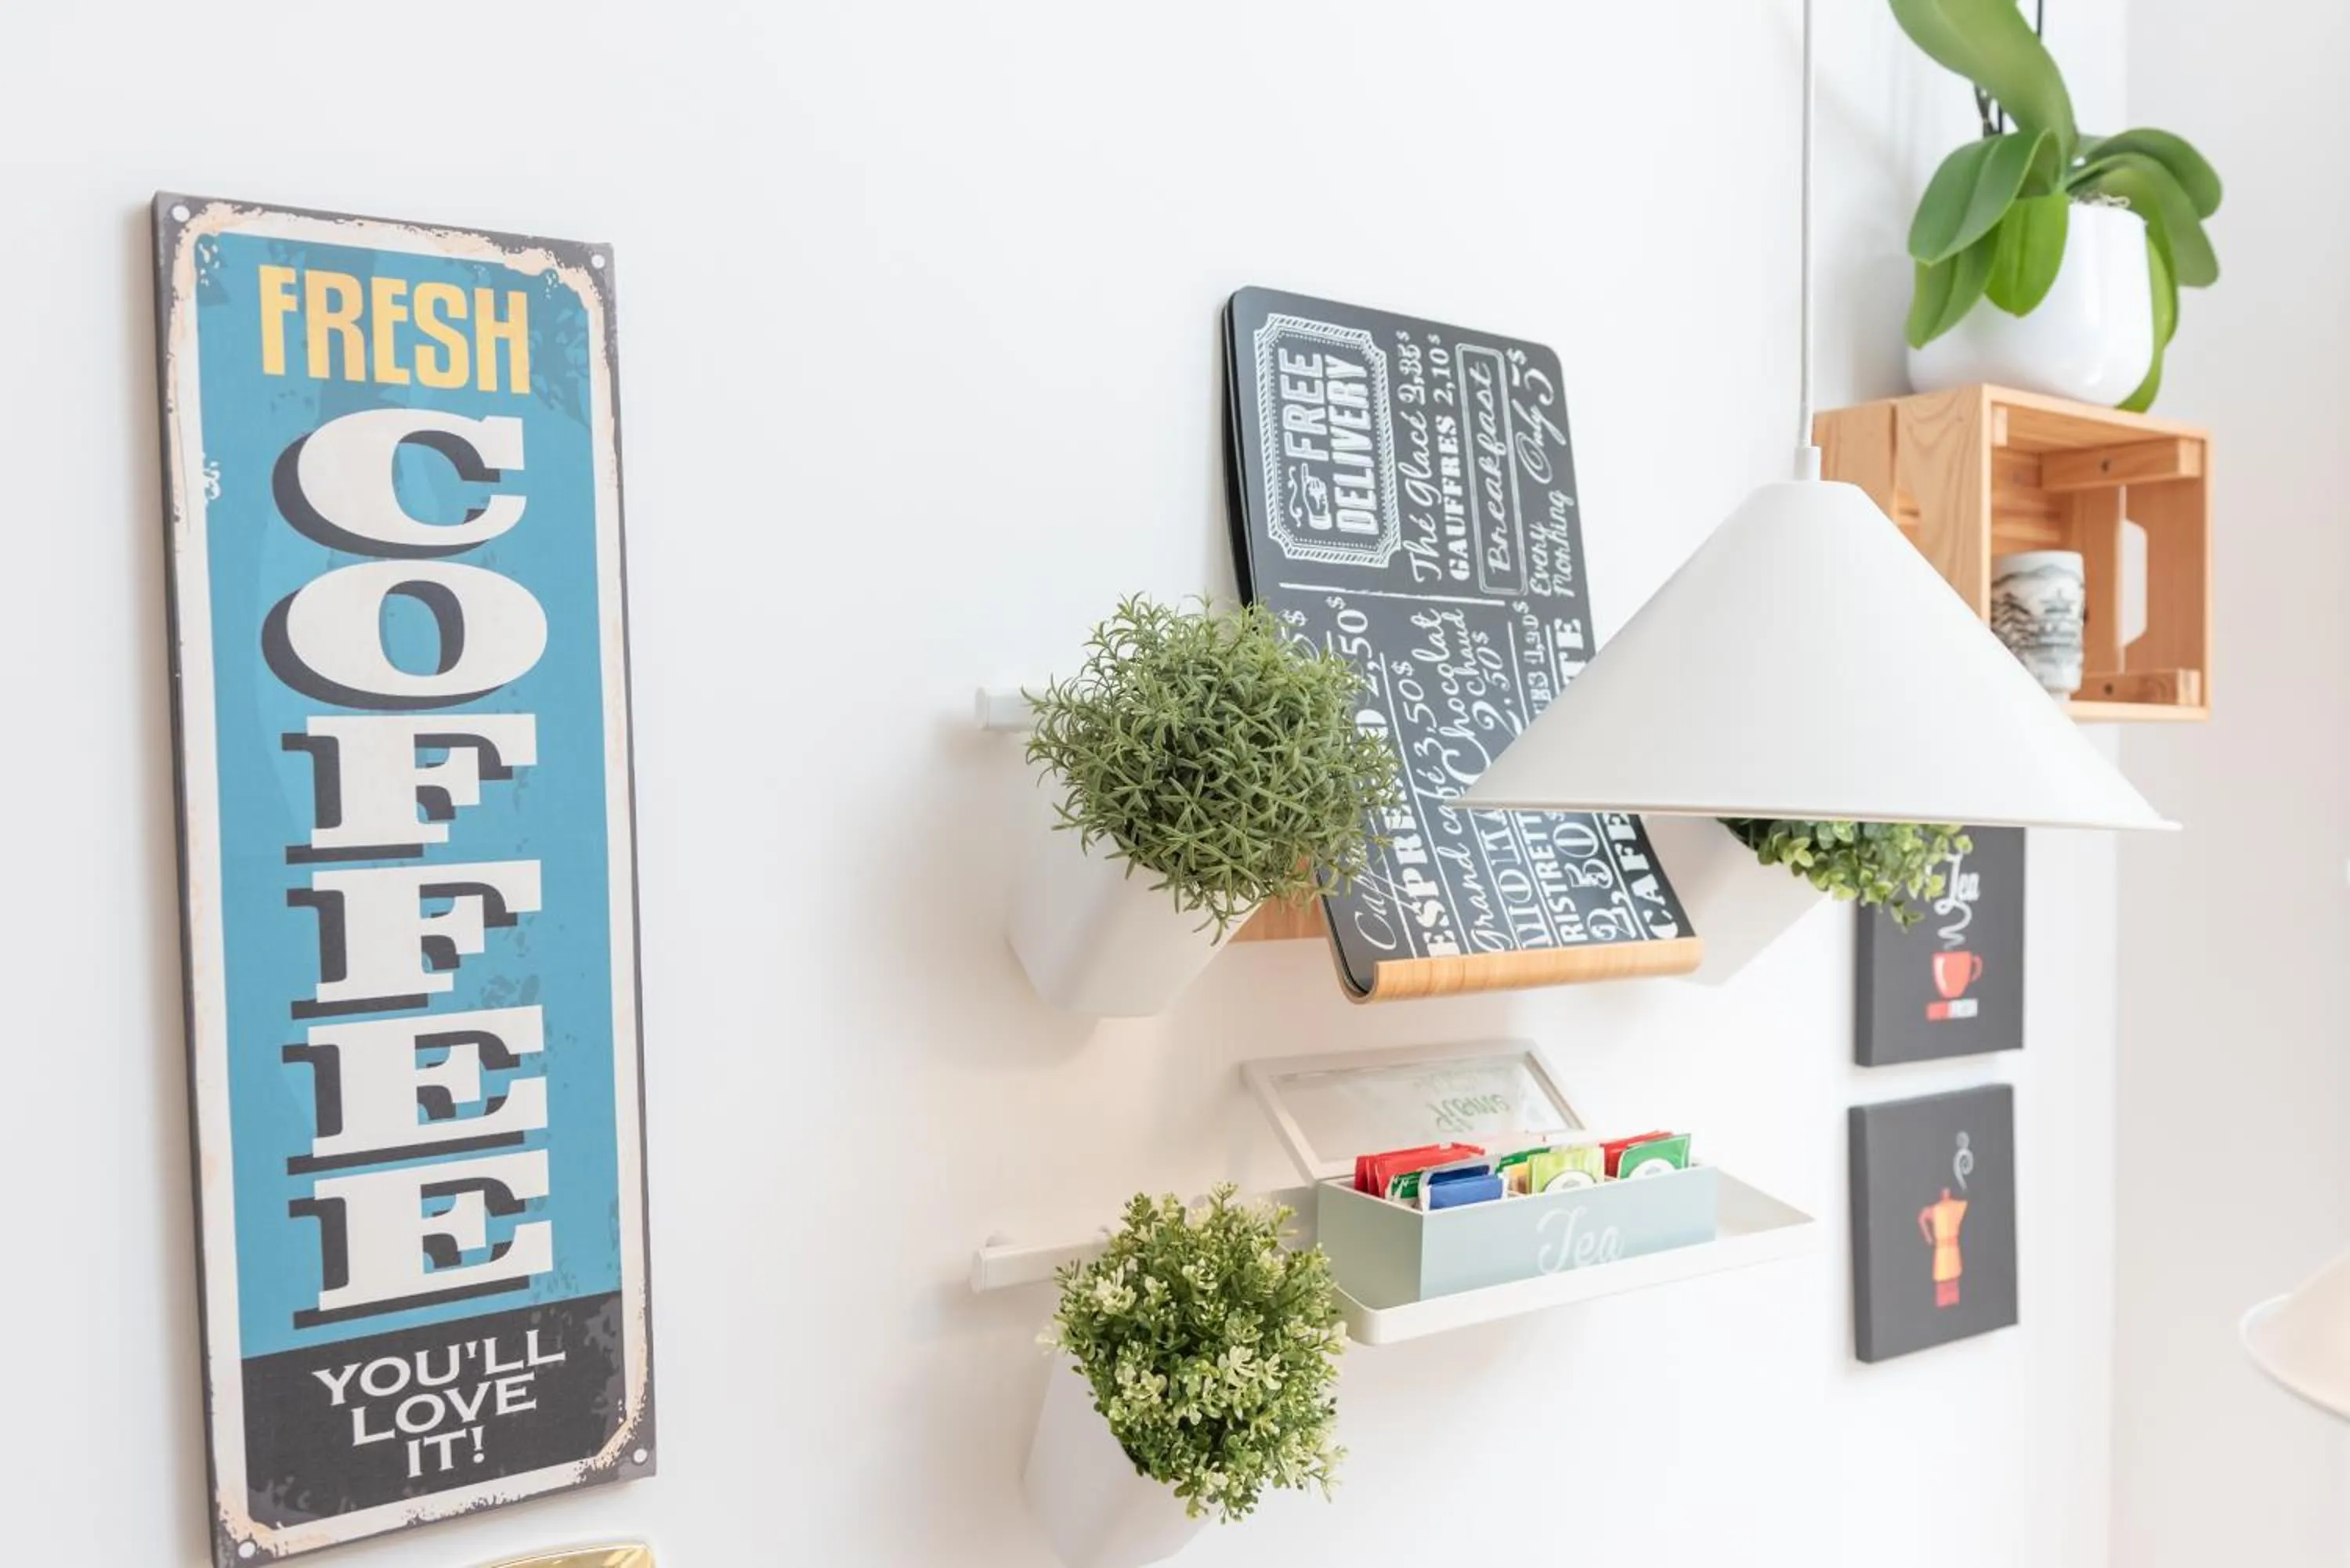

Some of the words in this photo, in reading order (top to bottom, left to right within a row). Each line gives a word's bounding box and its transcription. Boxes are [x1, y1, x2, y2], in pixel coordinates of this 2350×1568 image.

[258, 264, 530, 396] FRESH
[1278, 347, 1329, 461] FREE
[1325, 354, 1379, 535] DELIVERY
[1511, 399, 1567, 484] Only
[1436, 415, 1470, 580] GAUFFRES
[1470, 360, 1512, 575] Breakfast
[1402, 513, 1442, 583] Thé
[1528, 521, 1553, 598] Every
[1411, 608, 1493, 786] Chocolat
[262, 408, 554, 1329] COFFEE
[1516, 811, 1589, 944] RISTRETT
[1606, 812, 1679, 939] CAFE
[1536, 1205, 1625, 1274] Tea
[313, 1330, 566, 1407] YOU'LL
[351, 1371, 537, 1447] LOVE
[406, 1427, 484, 1479] IT!
